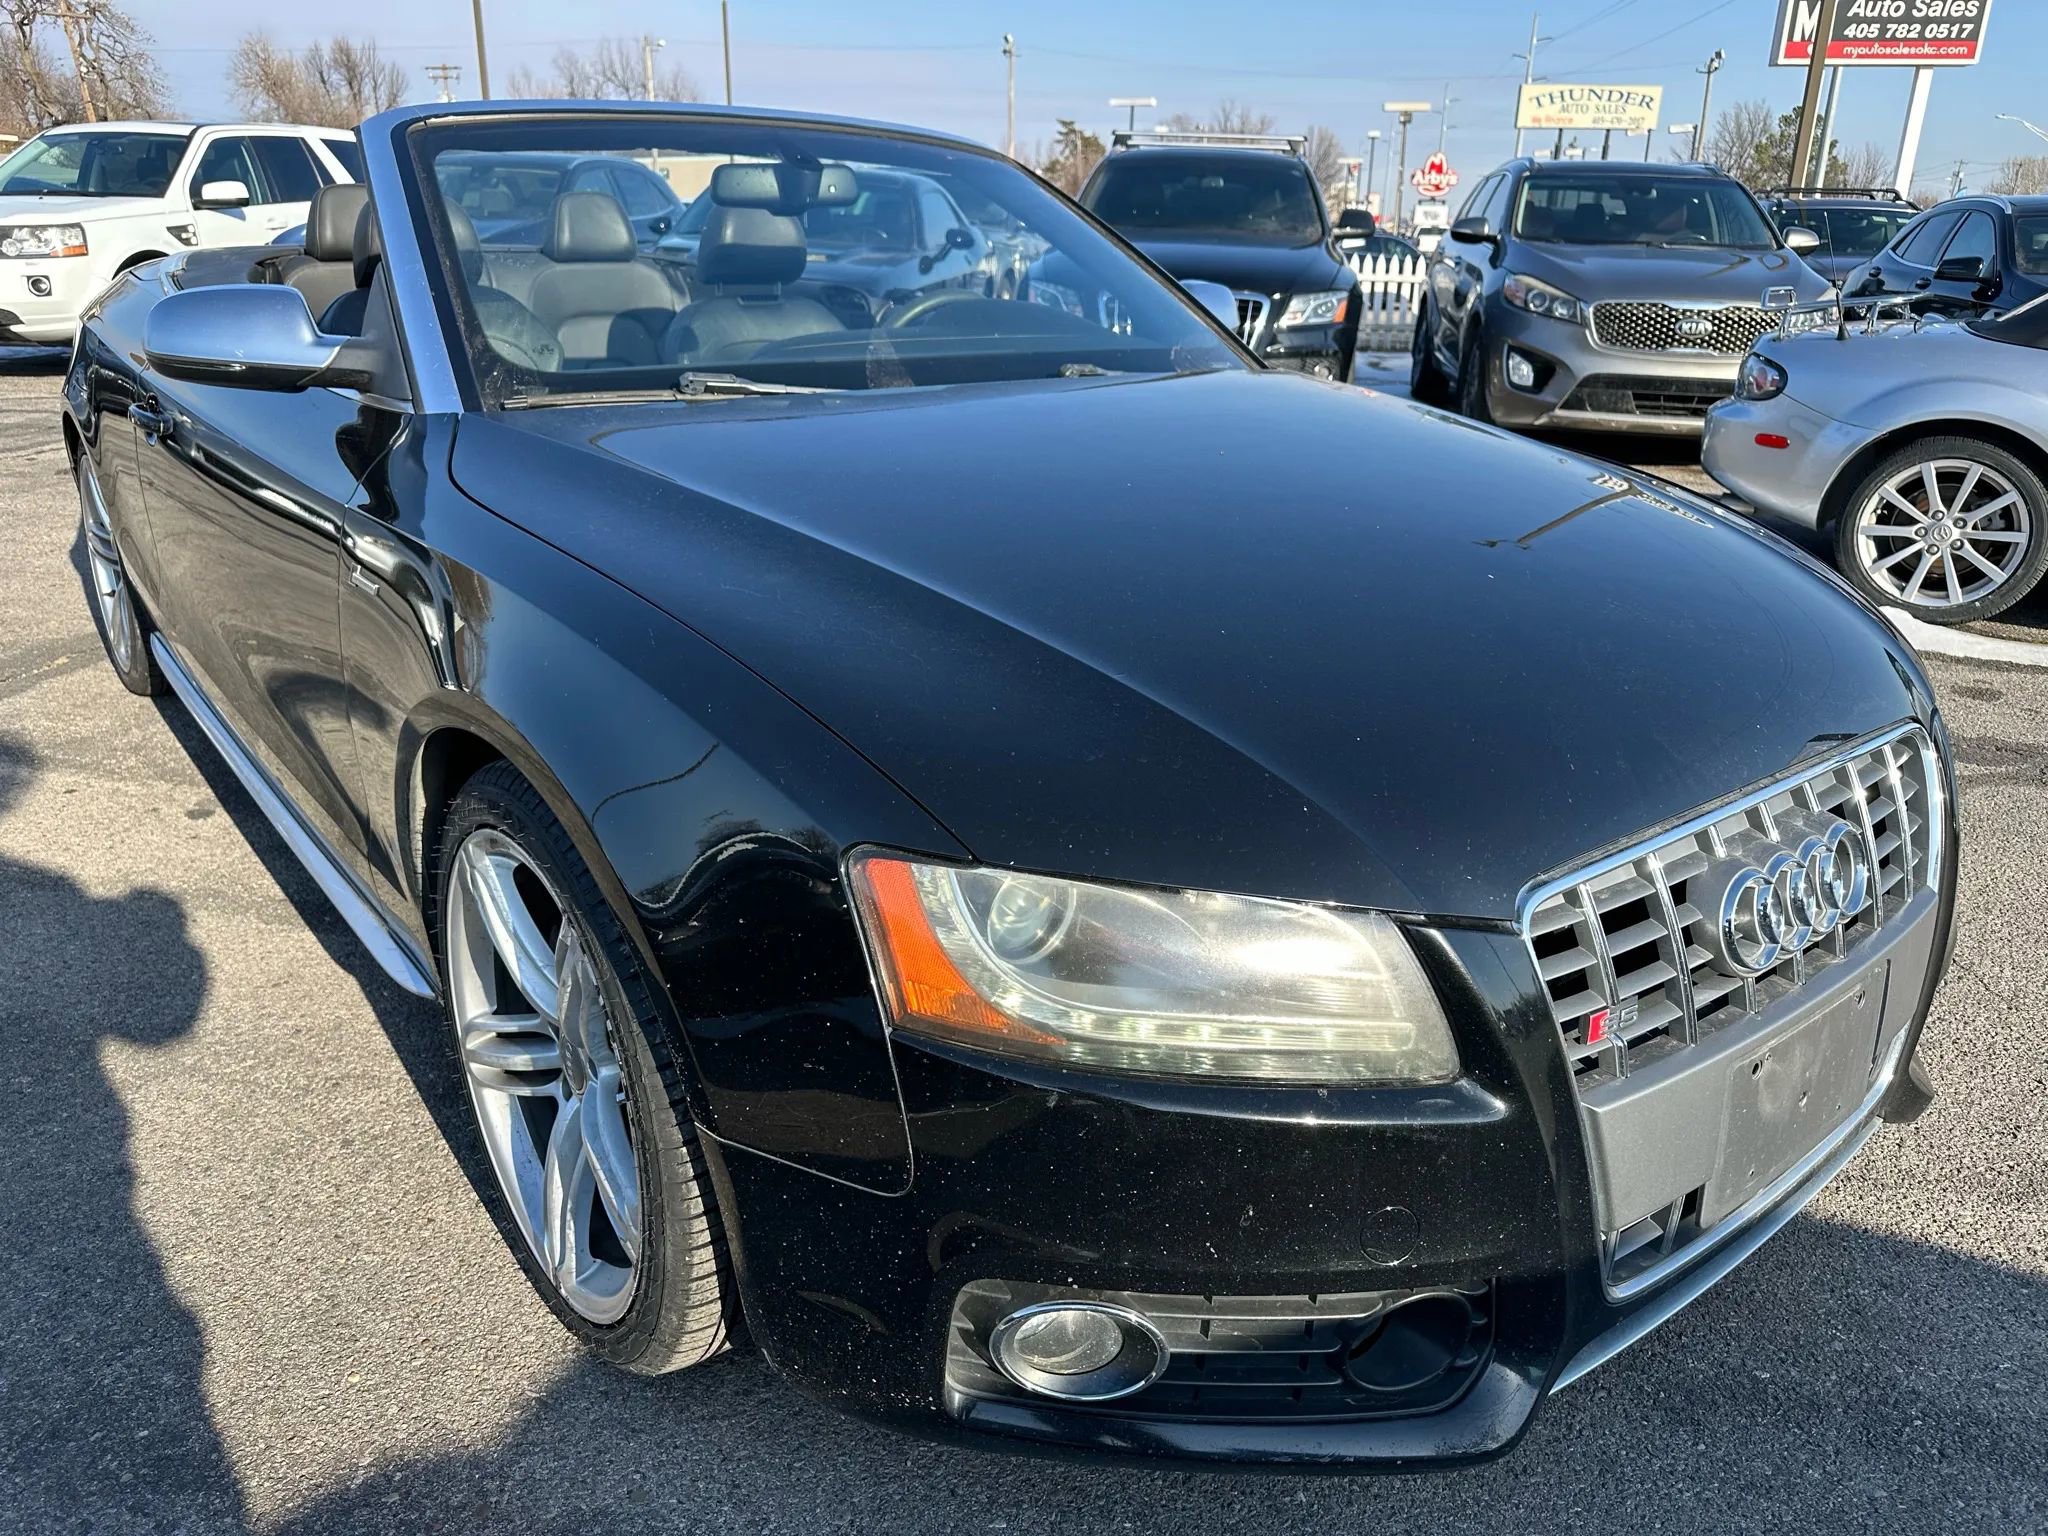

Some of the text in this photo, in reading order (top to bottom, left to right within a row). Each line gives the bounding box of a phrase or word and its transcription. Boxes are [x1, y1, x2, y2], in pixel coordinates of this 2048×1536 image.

[1846, 0, 1980, 18] Auto Sales
[1843, 23, 1974, 39] 405 782 0517
[1843, 42, 1968, 59] mjautosalesokc.com
[1529, 87, 1655, 111] THUNDER
[1559, 103, 1627, 115] AUTO SALES
[1681, 321, 1706, 335] KIA
